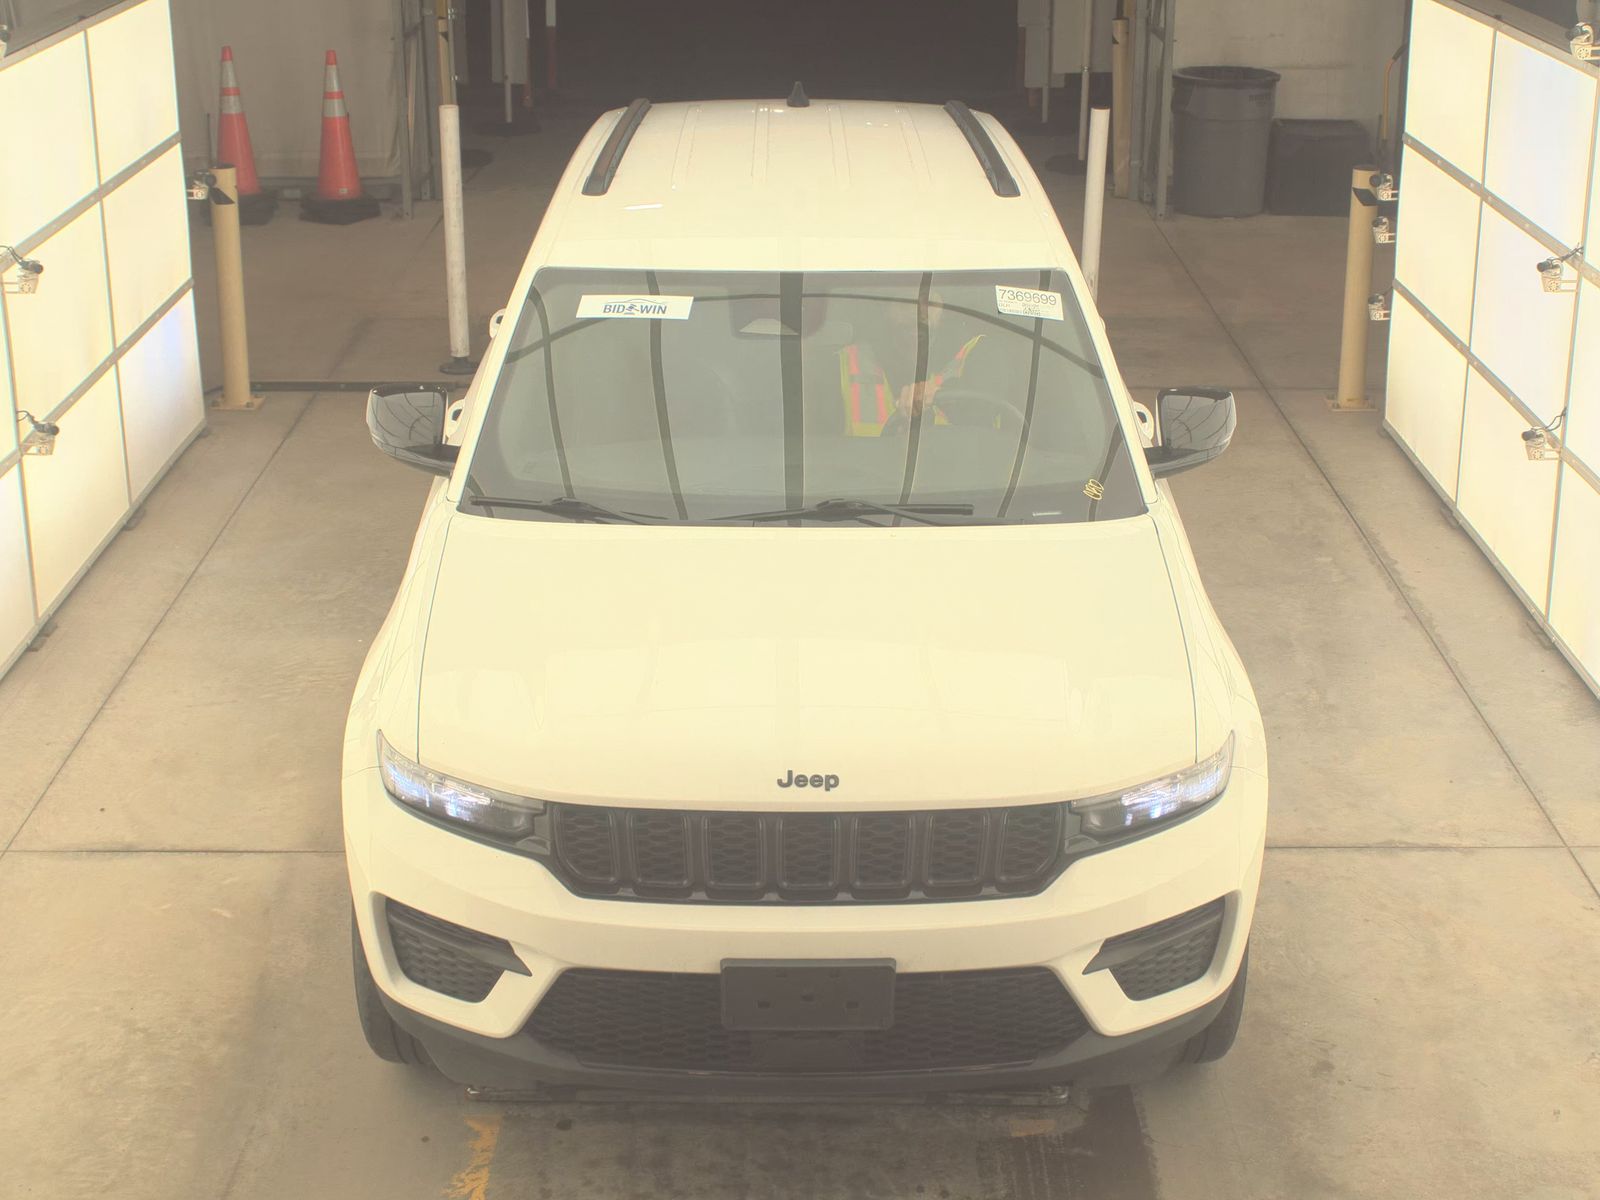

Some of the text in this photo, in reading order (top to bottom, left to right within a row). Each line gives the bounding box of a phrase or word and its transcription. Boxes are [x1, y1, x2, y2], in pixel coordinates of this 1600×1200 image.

[998, 288, 1057, 306] 7369699
[603, 304, 667, 315] BID WIN
[777, 769, 840, 792] Jeep
